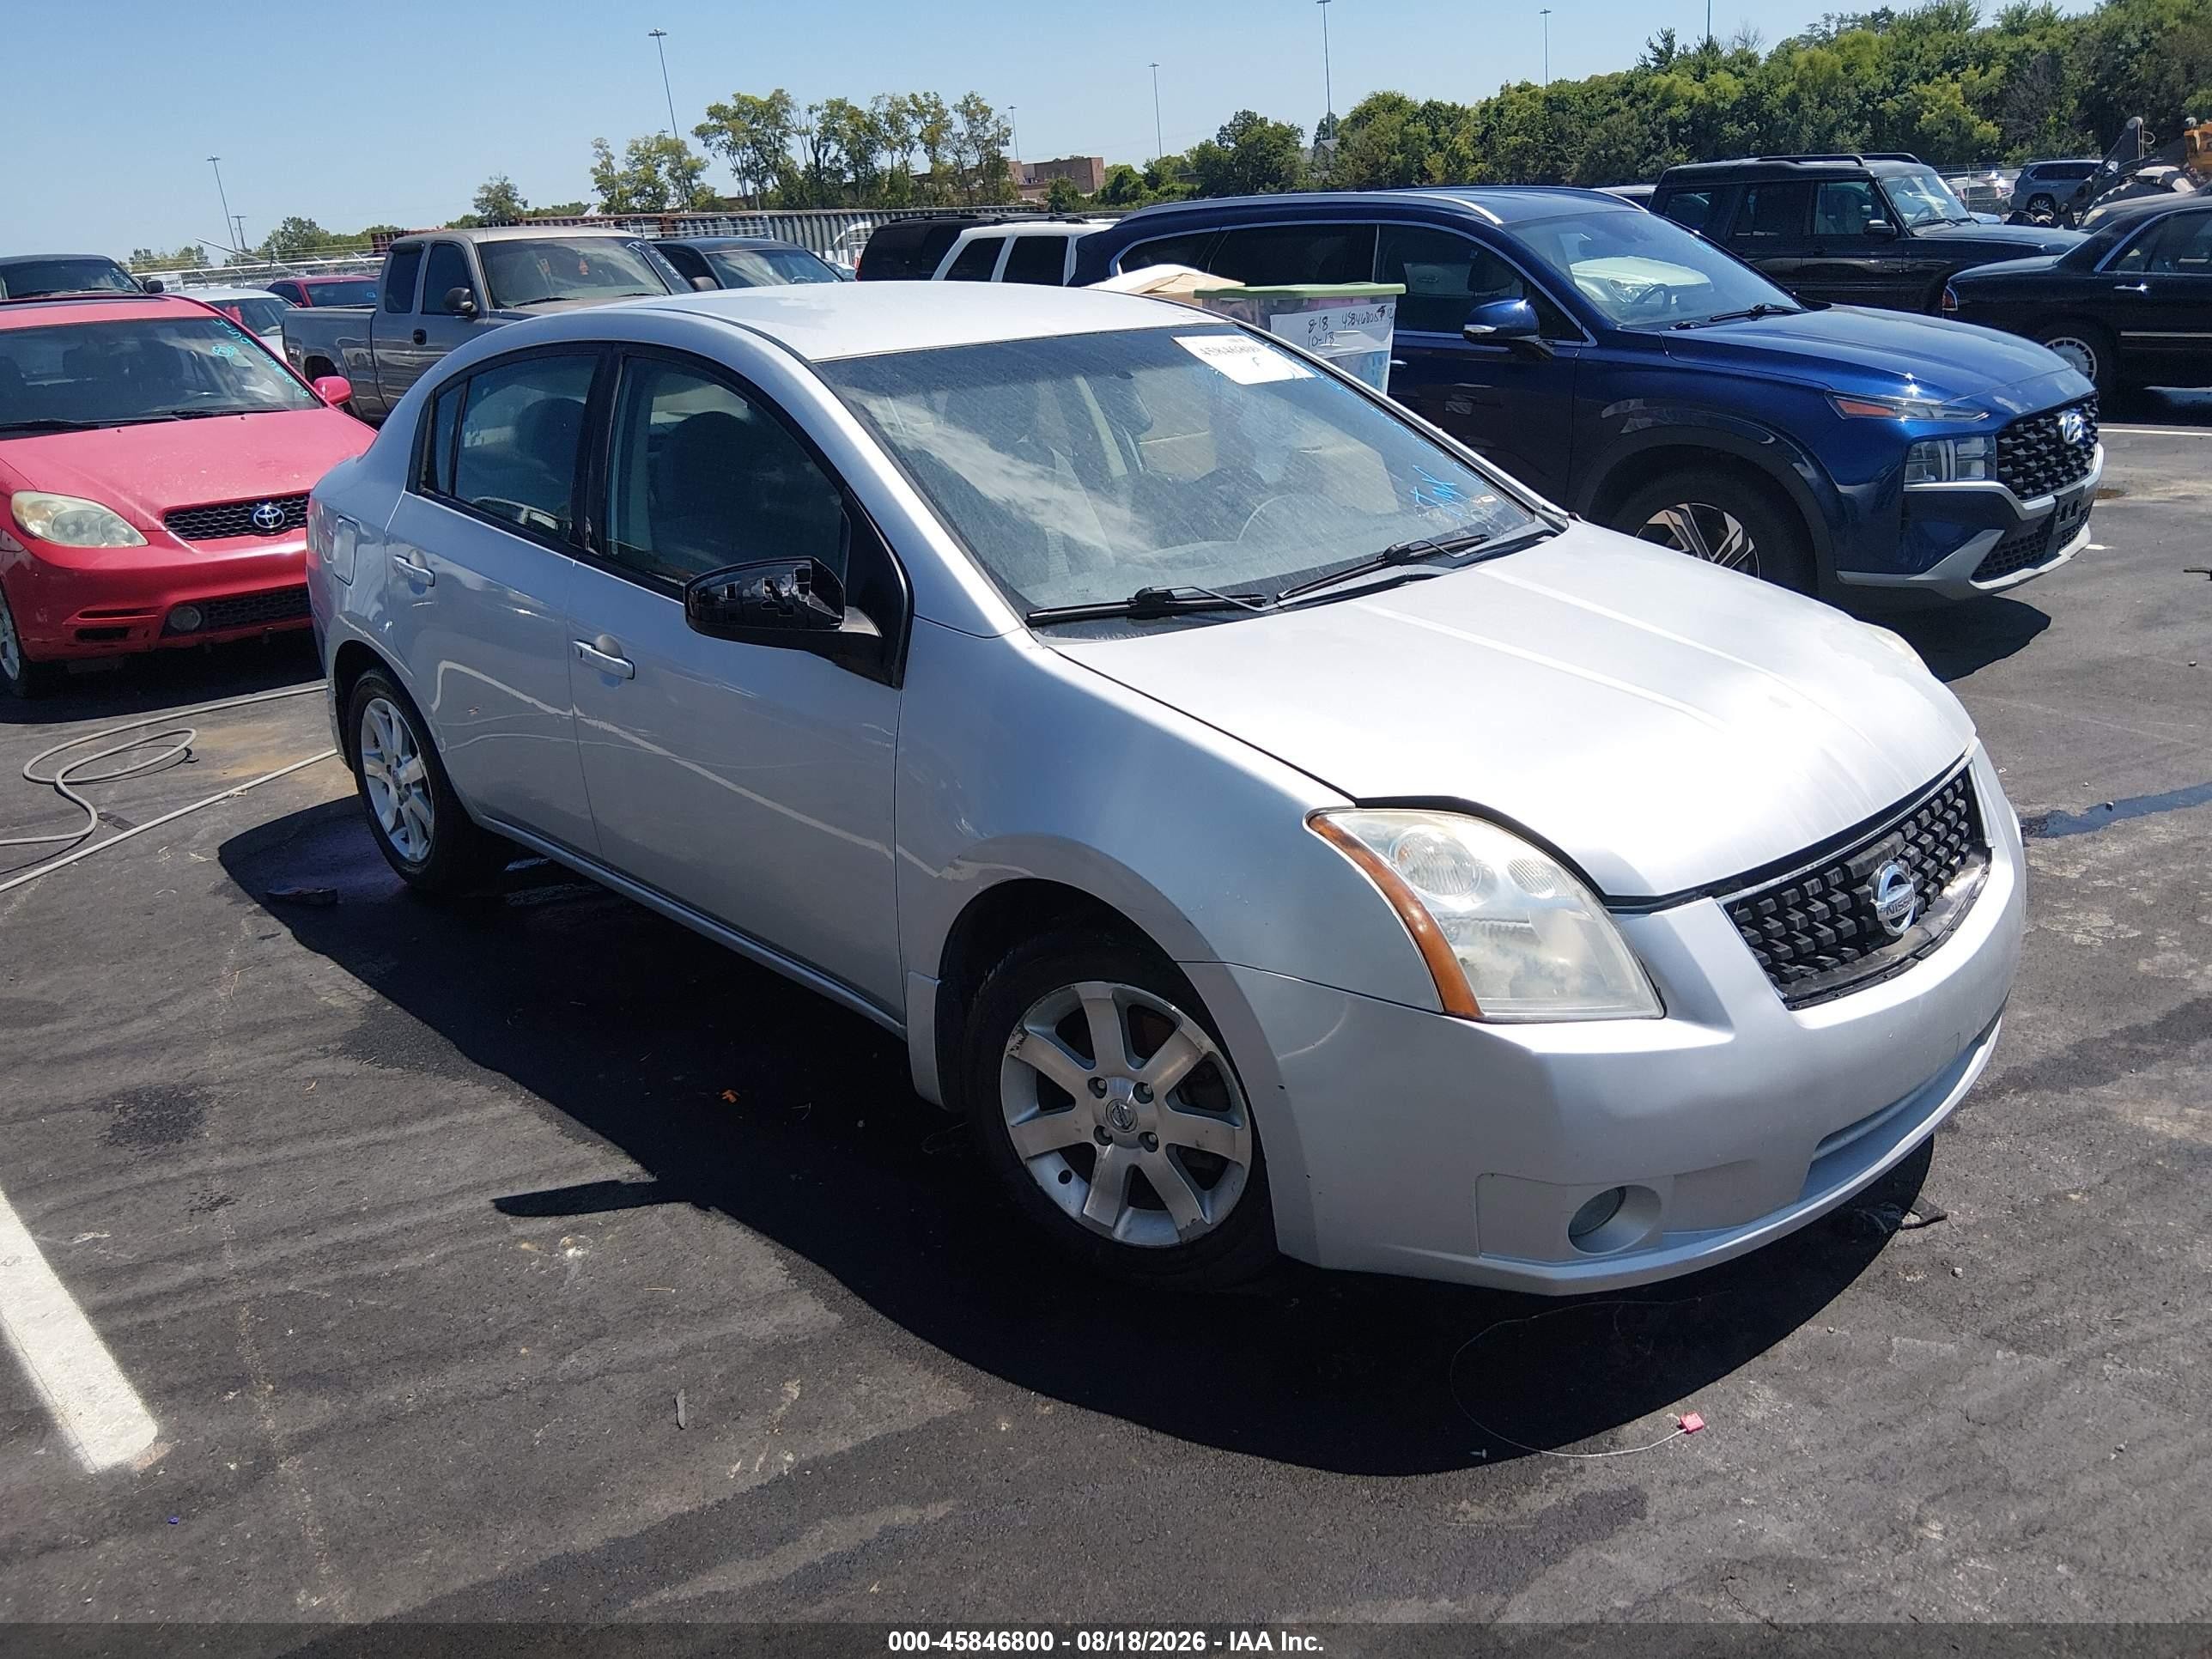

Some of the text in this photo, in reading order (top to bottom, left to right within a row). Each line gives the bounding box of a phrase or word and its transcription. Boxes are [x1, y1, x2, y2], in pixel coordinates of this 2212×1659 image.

[1308, 315, 1328, 334] 8-18
[1307, 331, 1335, 349] 10-18
[1885, 893, 1915, 916] NISS
